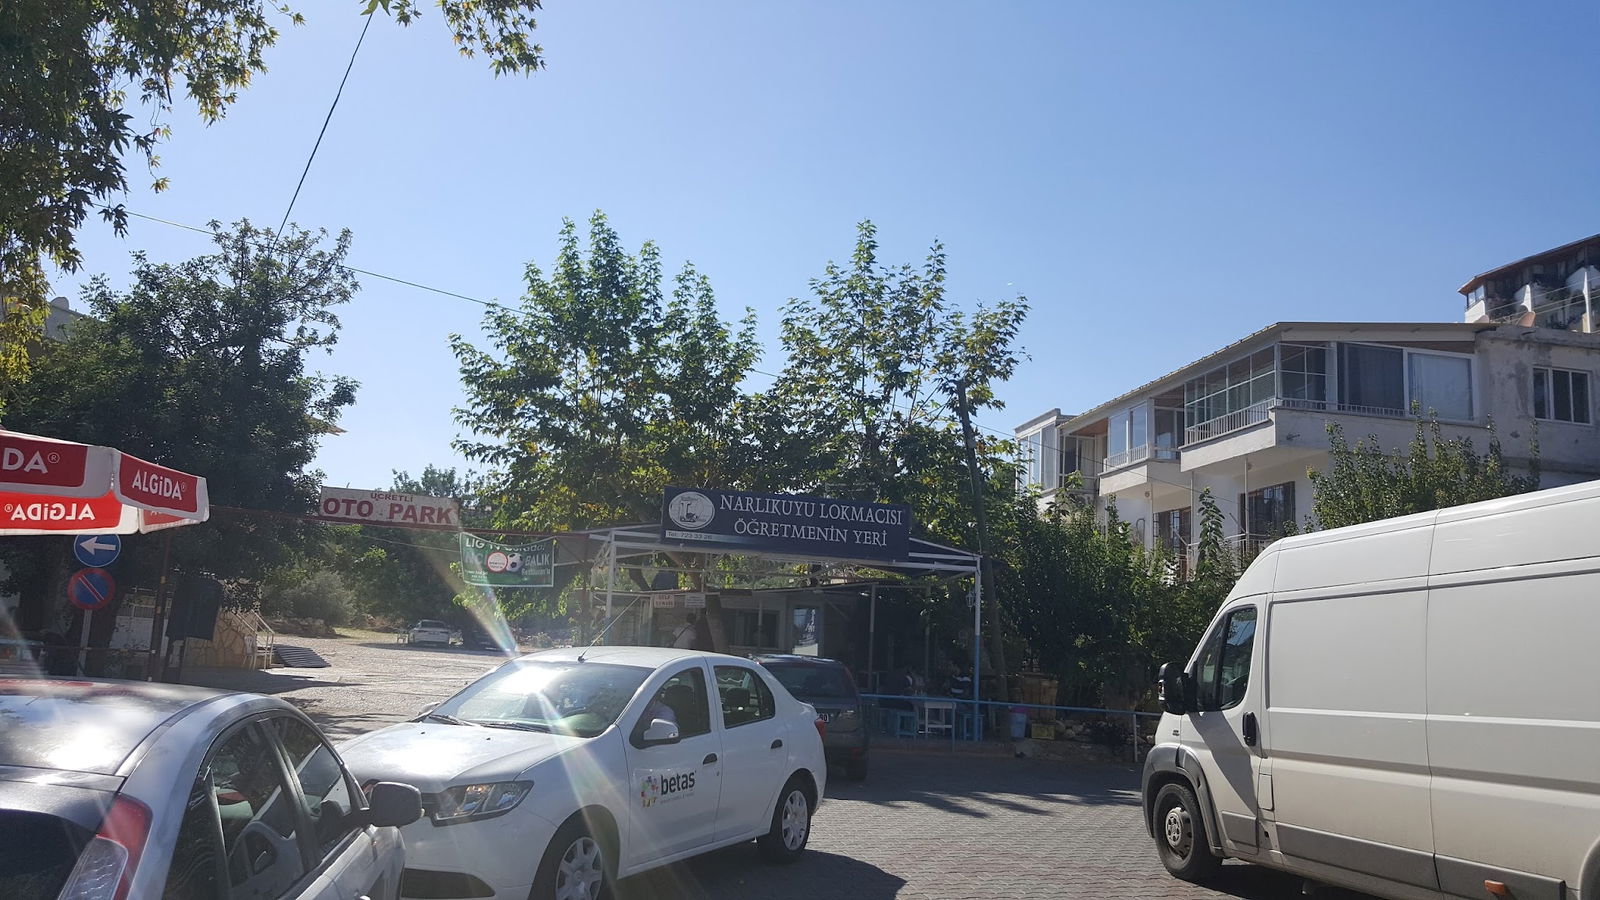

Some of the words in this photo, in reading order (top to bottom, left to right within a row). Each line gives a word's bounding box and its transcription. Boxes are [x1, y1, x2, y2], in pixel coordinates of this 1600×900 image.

[323, 497, 374, 518] OTO
[388, 502, 452, 524] PARK
[719, 494, 816, 518] NARLIKUYU
[819, 502, 903, 526] LOKMACISI
[734, 518, 848, 543] ÖĞRETMENİN
[853, 529, 888, 547] YERİ
